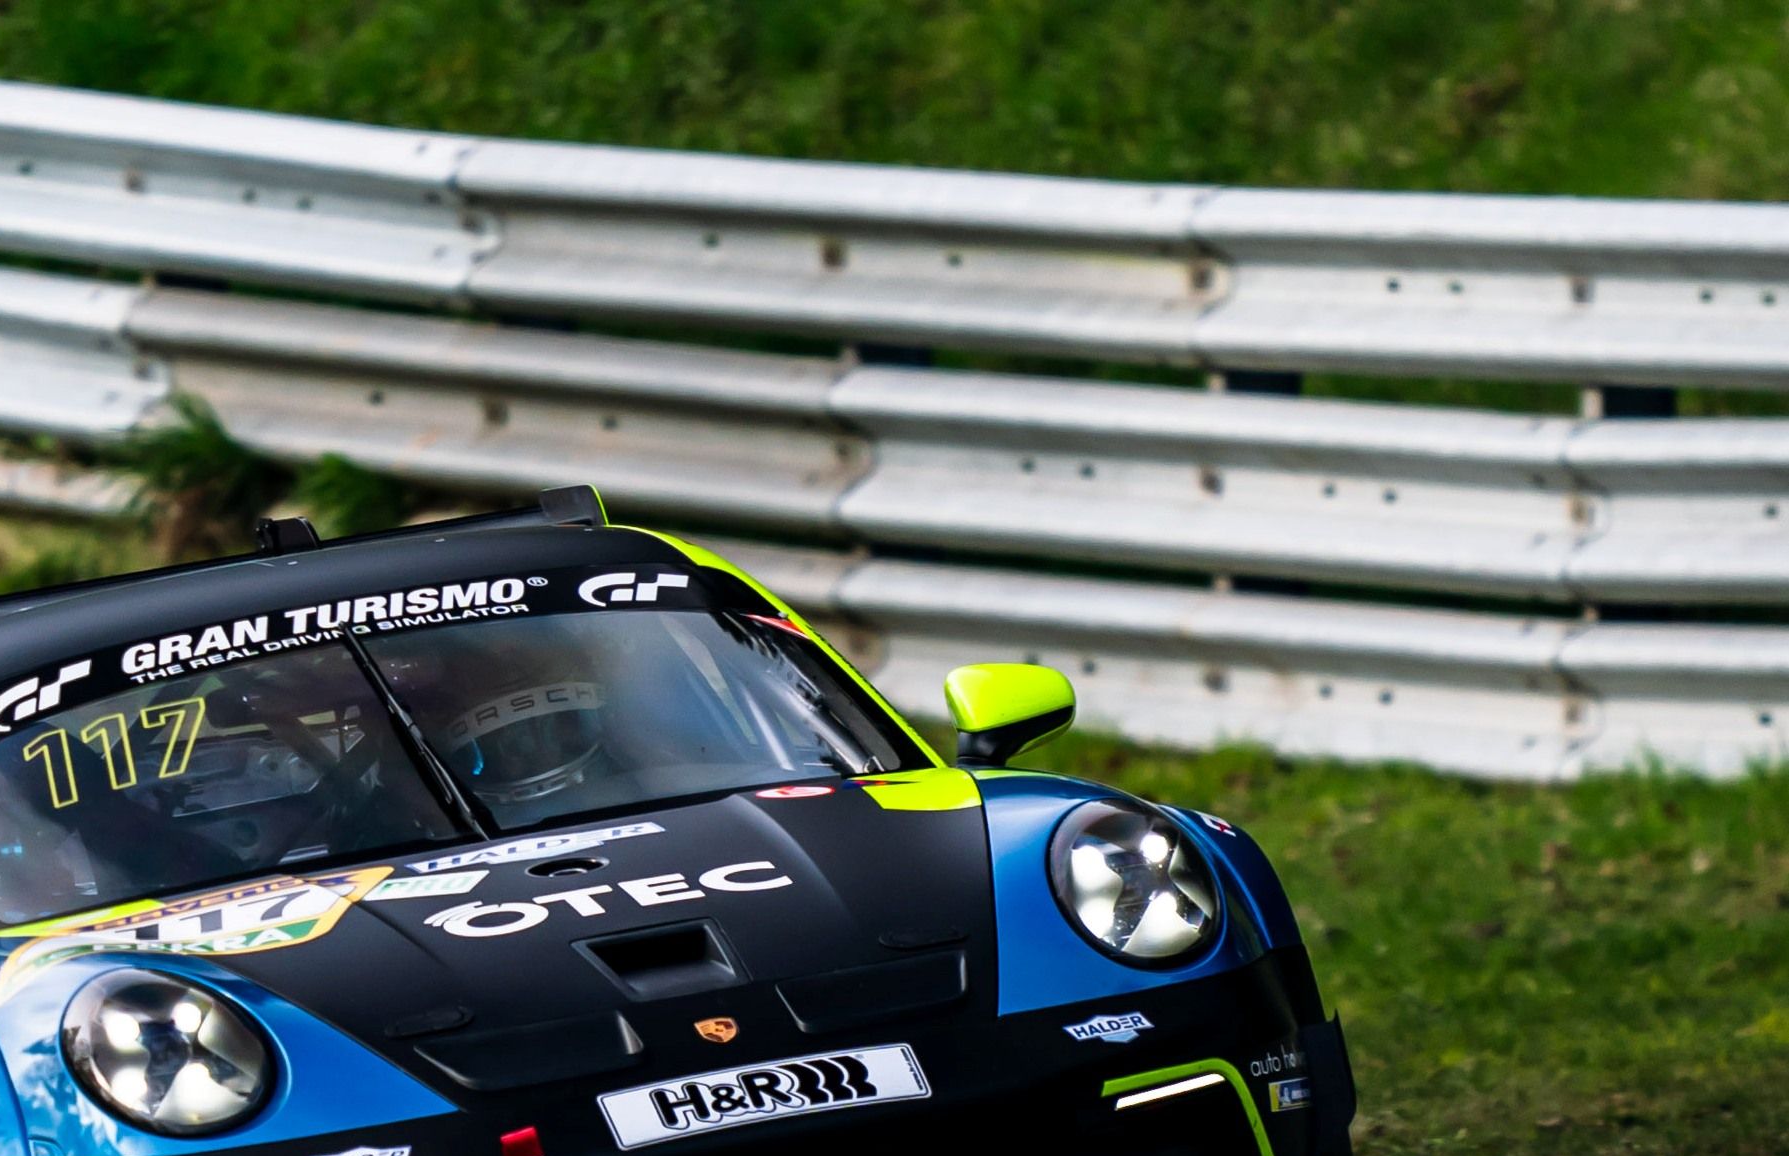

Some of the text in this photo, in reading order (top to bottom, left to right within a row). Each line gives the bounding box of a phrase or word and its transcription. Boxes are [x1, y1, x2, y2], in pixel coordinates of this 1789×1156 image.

[122, 616, 269, 675] GRAN
[130, 664, 185, 685] THE
[189, 648, 259, 670] REAL
[377, 603, 530, 631] SIMULATOR
[23, 697, 206, 808] 117
[426, 825, 646, 870] HALDER
[115, 889, 311, 941] 117
[423, 861, 794, 938] OTEC
[1073, 1013, 1145, 1039] HALDER
[1250, 1052, 1281, 1077] auto
[650, 1068, 804, 1130] H&R
